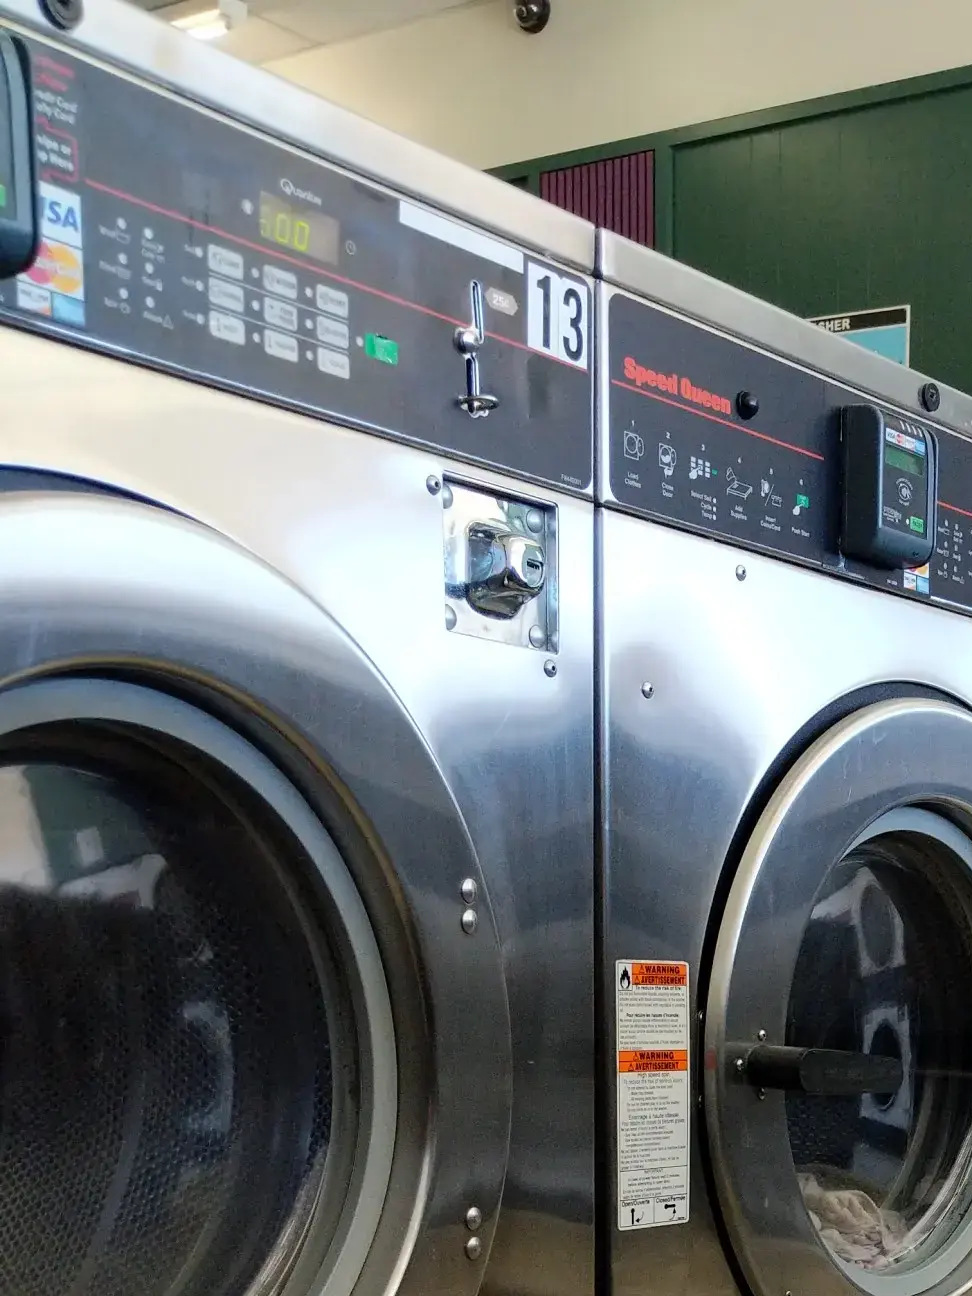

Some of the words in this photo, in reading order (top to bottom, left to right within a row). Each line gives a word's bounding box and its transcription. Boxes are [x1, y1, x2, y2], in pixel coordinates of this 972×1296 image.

[536, 275, 583, 361] 13
[818, 318, 850, 332] SHER
[624, 356, 678, 396] Speed
[680, 377, 732, 415] Queen
[645, 966, 680, 974] WARNING
[641, 976, 686, 985] AVERTISSEMENT
[640, 1052, 674, 1060] WARNING
[636, 1062, 679, 1071] AVERTISSEMENT
